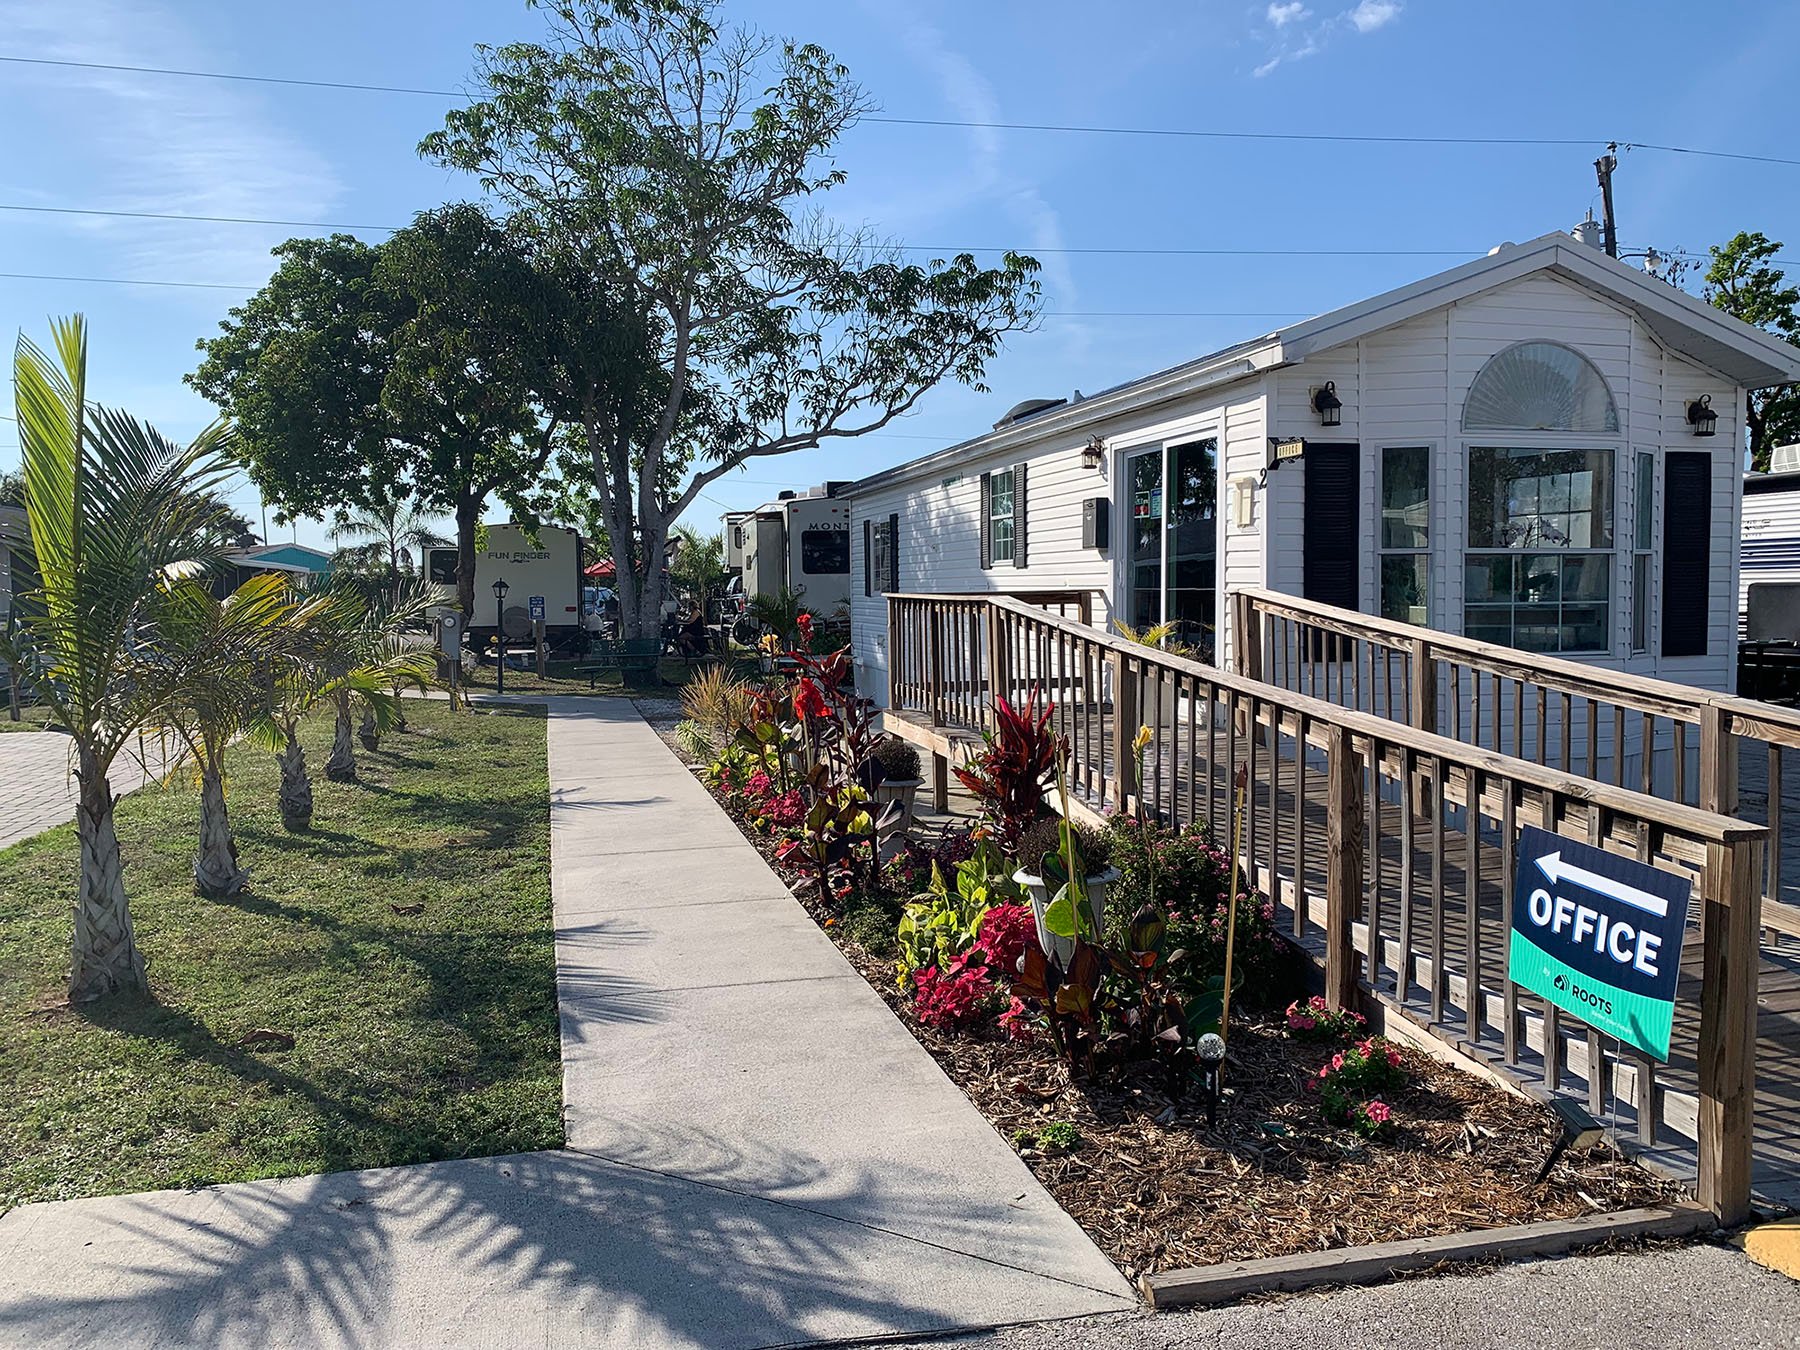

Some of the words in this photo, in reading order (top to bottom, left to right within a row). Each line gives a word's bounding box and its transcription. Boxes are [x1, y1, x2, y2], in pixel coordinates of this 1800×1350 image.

[1260, 467, 1267, 489] 2
[487, 552, 510, 560] FUN
[513, 552, 551, 560] FINDER
[1528, 888, 1662, 977] OFFICE
[1572, 985, 1612, 1015] ROOTS
